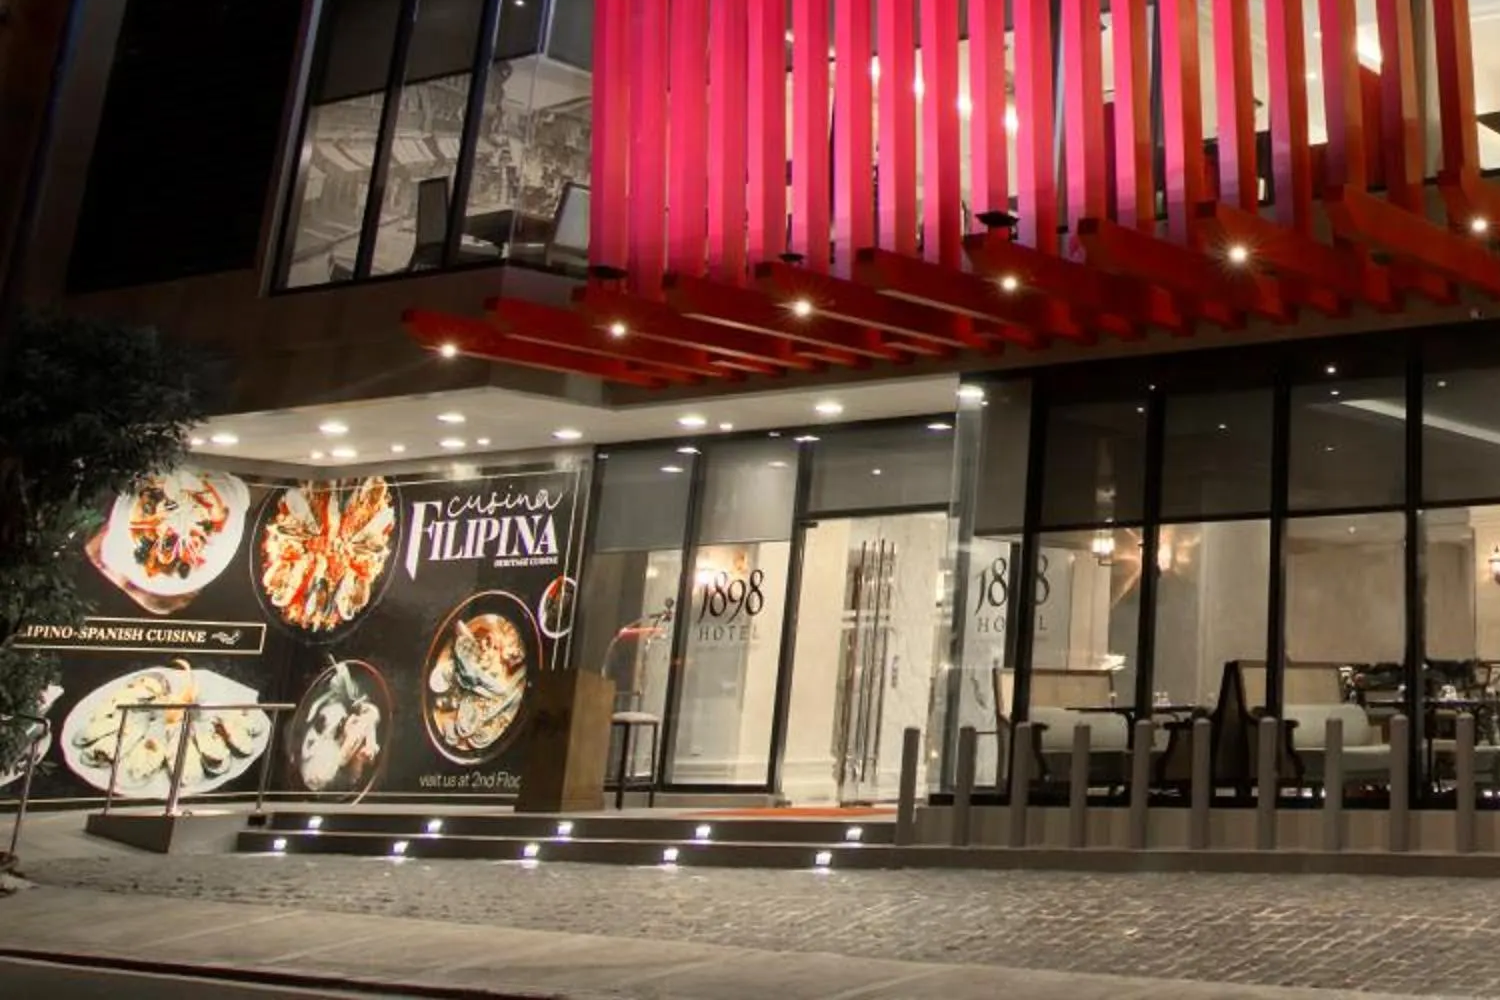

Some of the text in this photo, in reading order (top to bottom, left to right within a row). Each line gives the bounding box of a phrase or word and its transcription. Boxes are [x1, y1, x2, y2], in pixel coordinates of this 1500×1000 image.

[447, 485, 563, 517] cusina
[405, 500, 559, 581] FILIPINA
[697, 569, 763, 624] 1898
[977, 614, 1047, 632] HOL
[18, 625, 207, 643] IPINO-SPANISH CUISINE
[698, 625, 760, 641] HOTEL
[472, 771, 495, 788] 2nd
